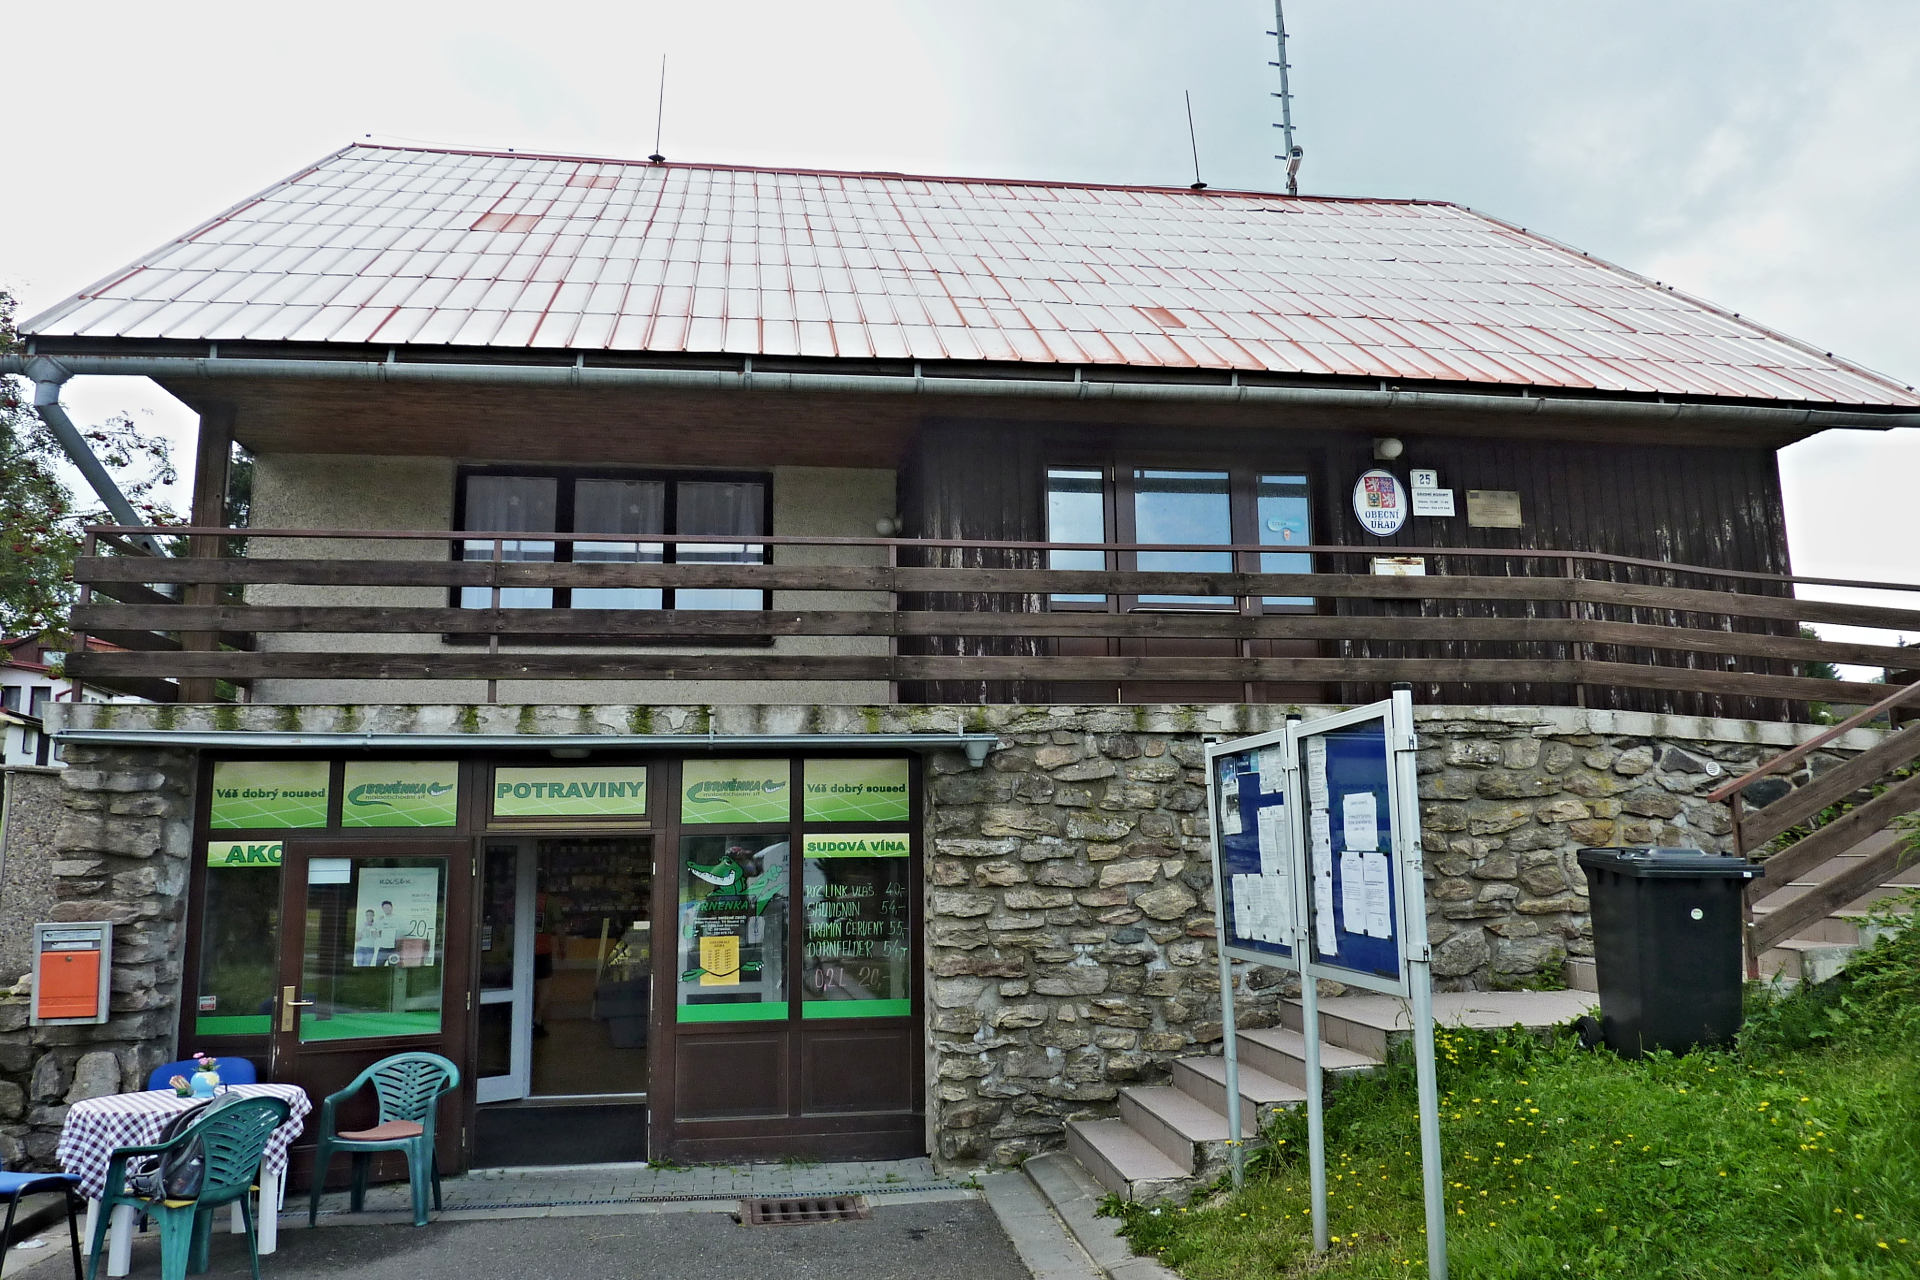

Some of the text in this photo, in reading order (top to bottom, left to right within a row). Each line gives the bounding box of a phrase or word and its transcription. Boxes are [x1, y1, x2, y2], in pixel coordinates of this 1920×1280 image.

[1419, 473, 1431, 485] 25
[1365, 509, 1400, 519] OBECNÍ
[1371, 518, 1396, 529] ÚŘAD
[365, 780, 427, 794] BRNĚNKA
[497, 781, 644, 799] POTRAVINY
[703, 778, 761, 792] BRNĚNKA
[807, 783, 906, 795] Váš dobrý soused
[216, 788, 326, 801] Váš dobrý soused
[807, 839, 906, 852] SUDOVÁ VÍNA
[806, 939, 874, 958] DORNFELDER
